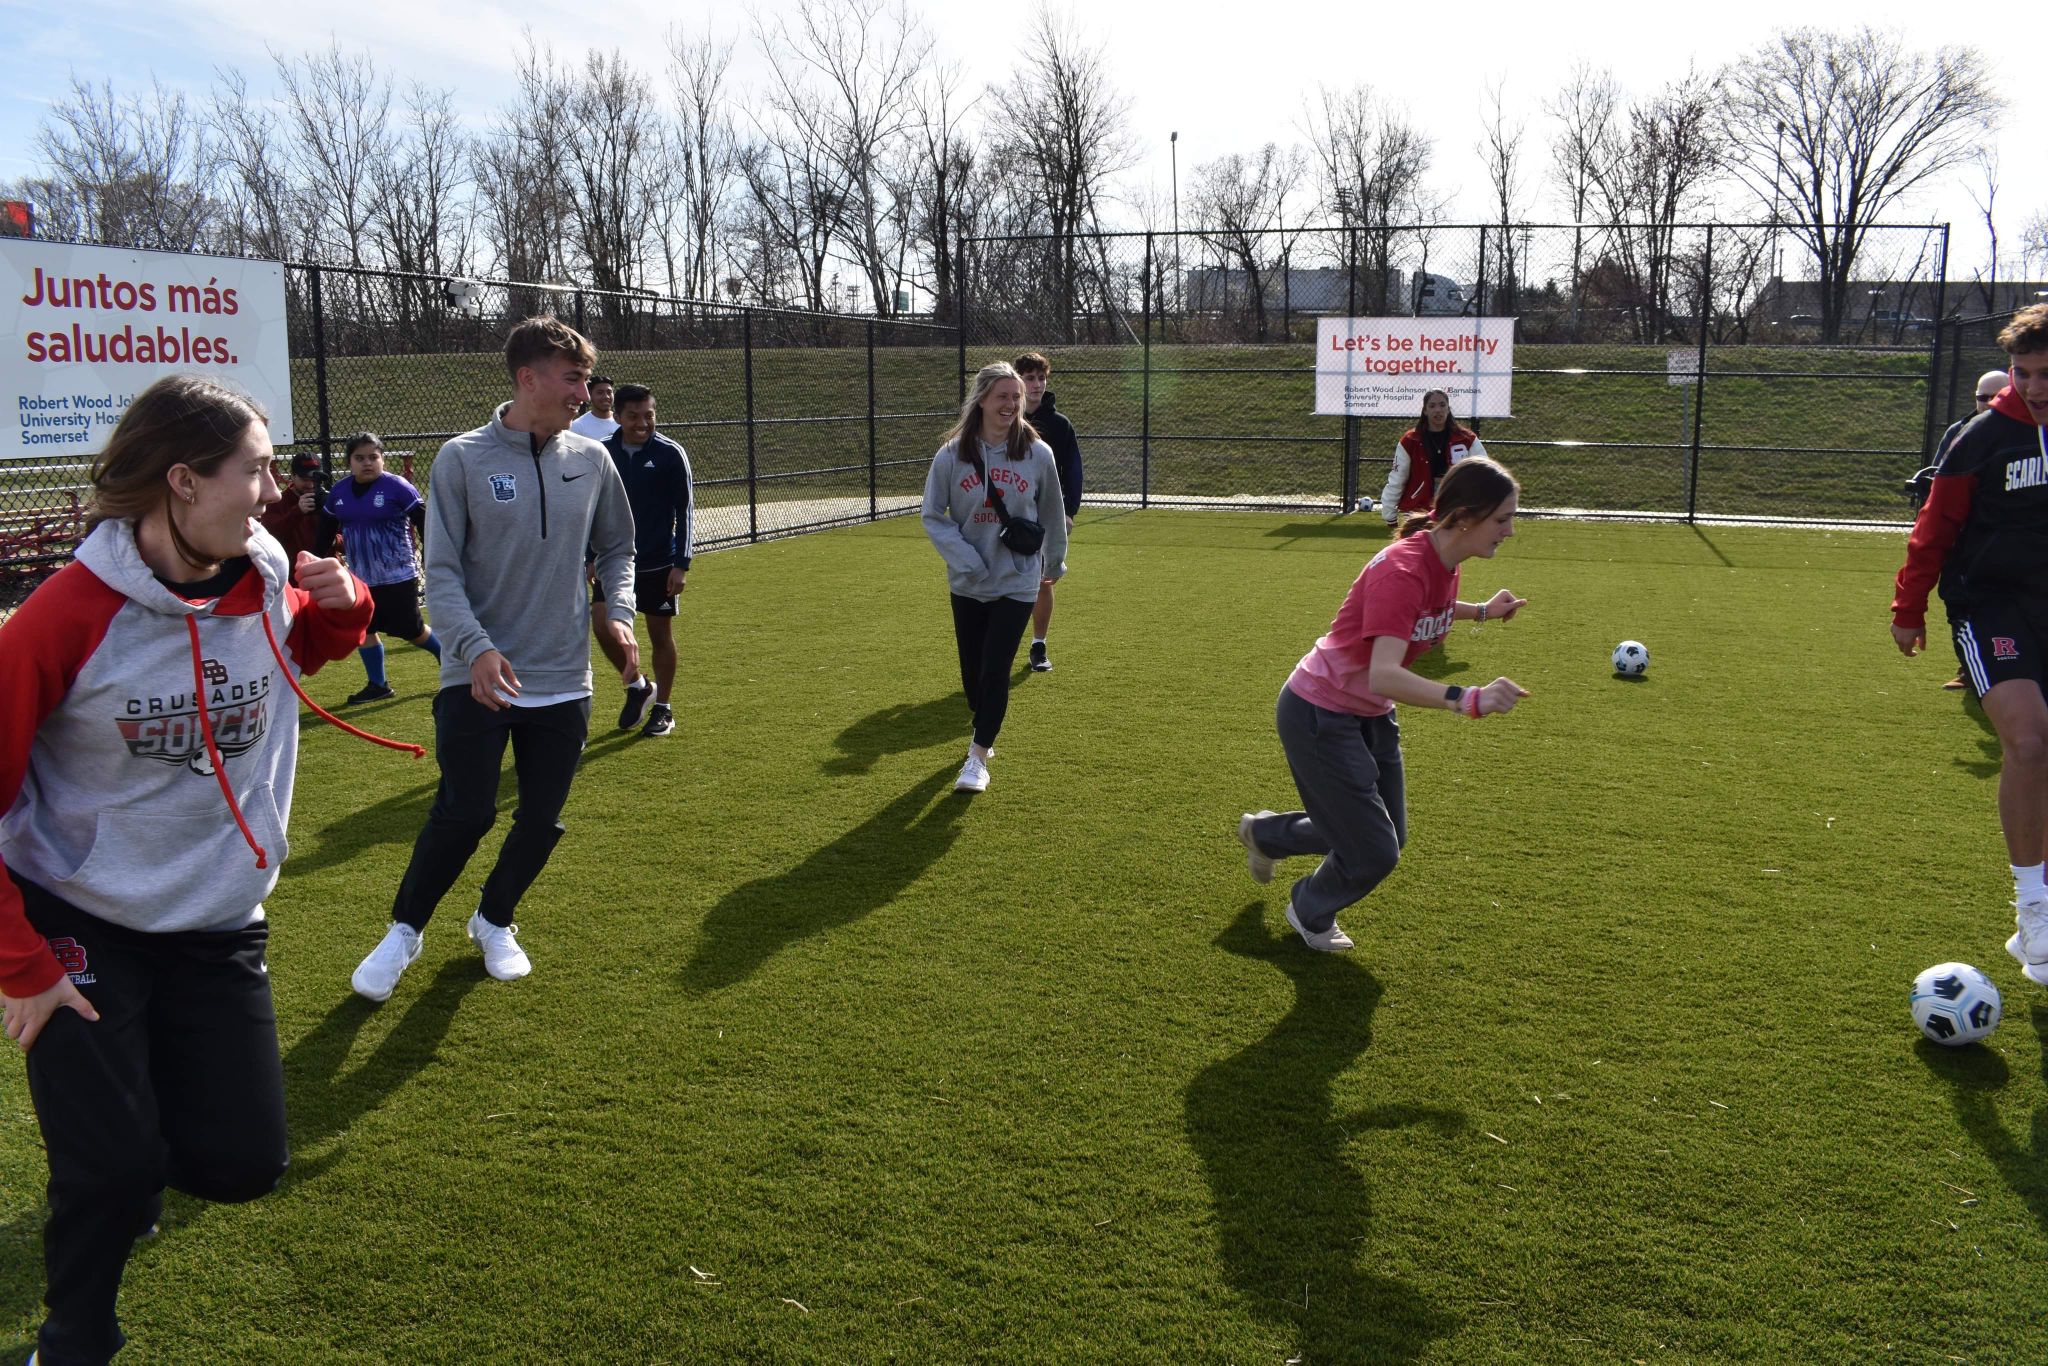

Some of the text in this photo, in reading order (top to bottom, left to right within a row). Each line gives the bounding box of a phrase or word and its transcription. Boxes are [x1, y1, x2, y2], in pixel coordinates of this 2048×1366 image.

[23, 268, 239, 315] Juntos más
[27, 323, 238, 364] saludables.
[1332, 335, 1498, 355] Let's be healthy
[1365, 357, 1462, 376] together.
[19, 395, 69, 410] Robert
[72, 394, 112, 408] Wood
[1344, 394, 1414, 402] University Hospital
[20, 412, 91, 429] University
[22, 430, 89, 445] Somerset
[960, 468, 1028, 494] RUGERS
[1992, 637, 2020, 656] R
